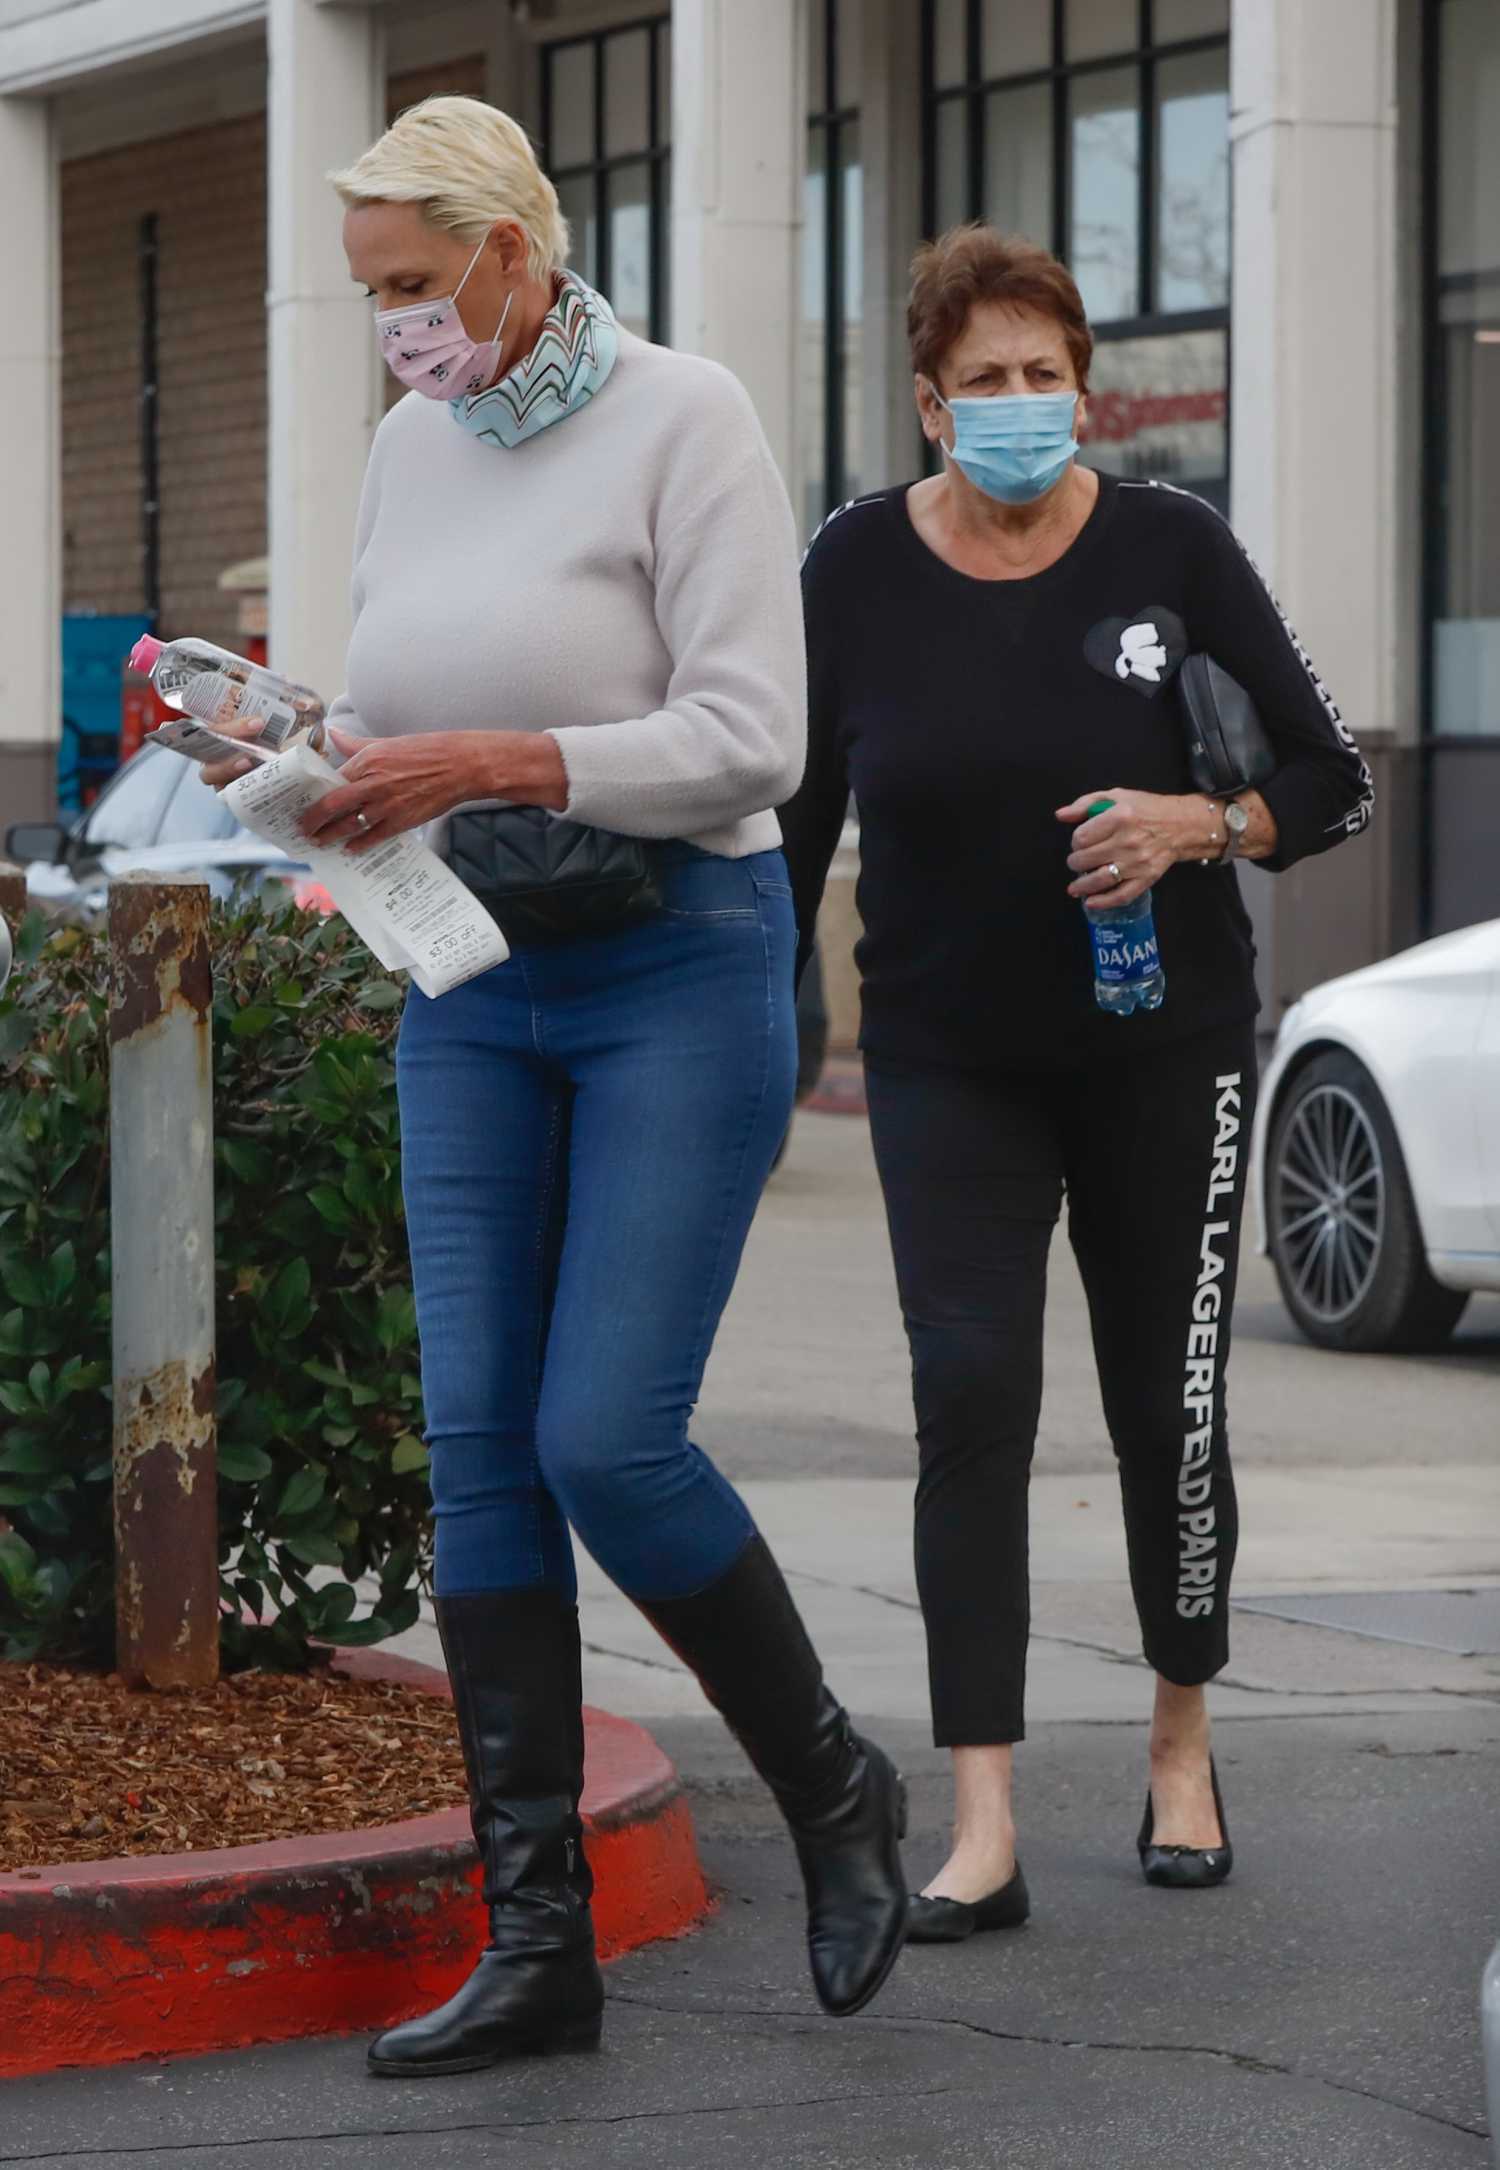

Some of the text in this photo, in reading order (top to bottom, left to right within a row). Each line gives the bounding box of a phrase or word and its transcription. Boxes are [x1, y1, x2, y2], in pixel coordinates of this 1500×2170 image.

[1176, 1072, 1241, 1619] KARL LAGERFELD PARIS
